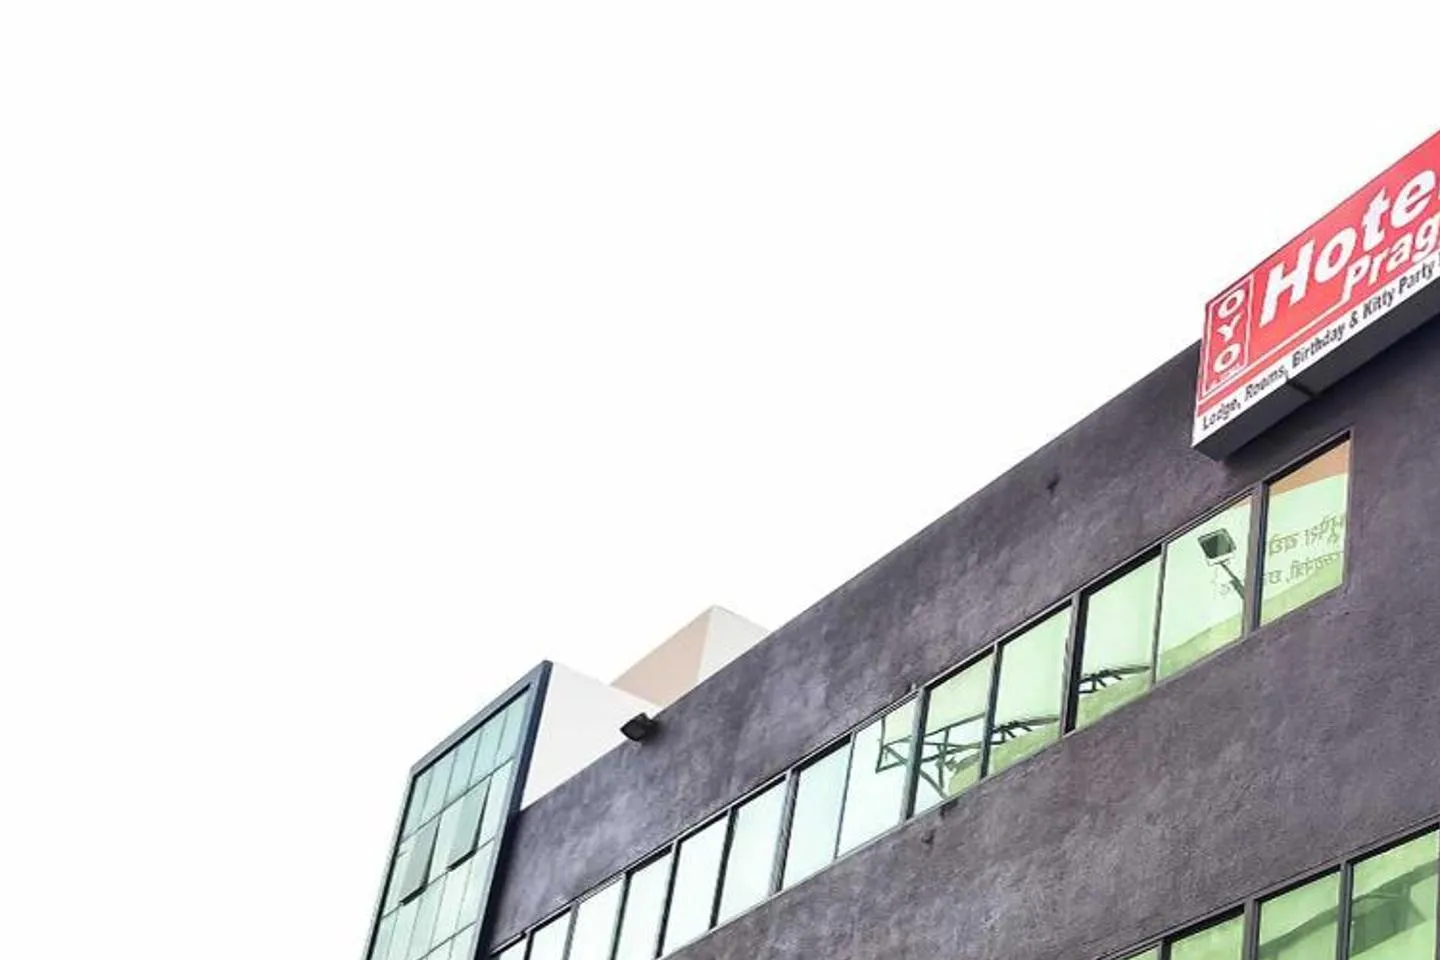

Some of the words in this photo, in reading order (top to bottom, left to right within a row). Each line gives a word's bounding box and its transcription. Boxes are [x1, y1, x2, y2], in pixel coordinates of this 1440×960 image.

[1214, 288, 1245, 373] OYO
[1292, 323, 1346, 369] Birthday
[1349, 310, 1359, 329] &
[1362, 287, 1396, 319] Kitty
[1398, 260, 1435, 294] Party
